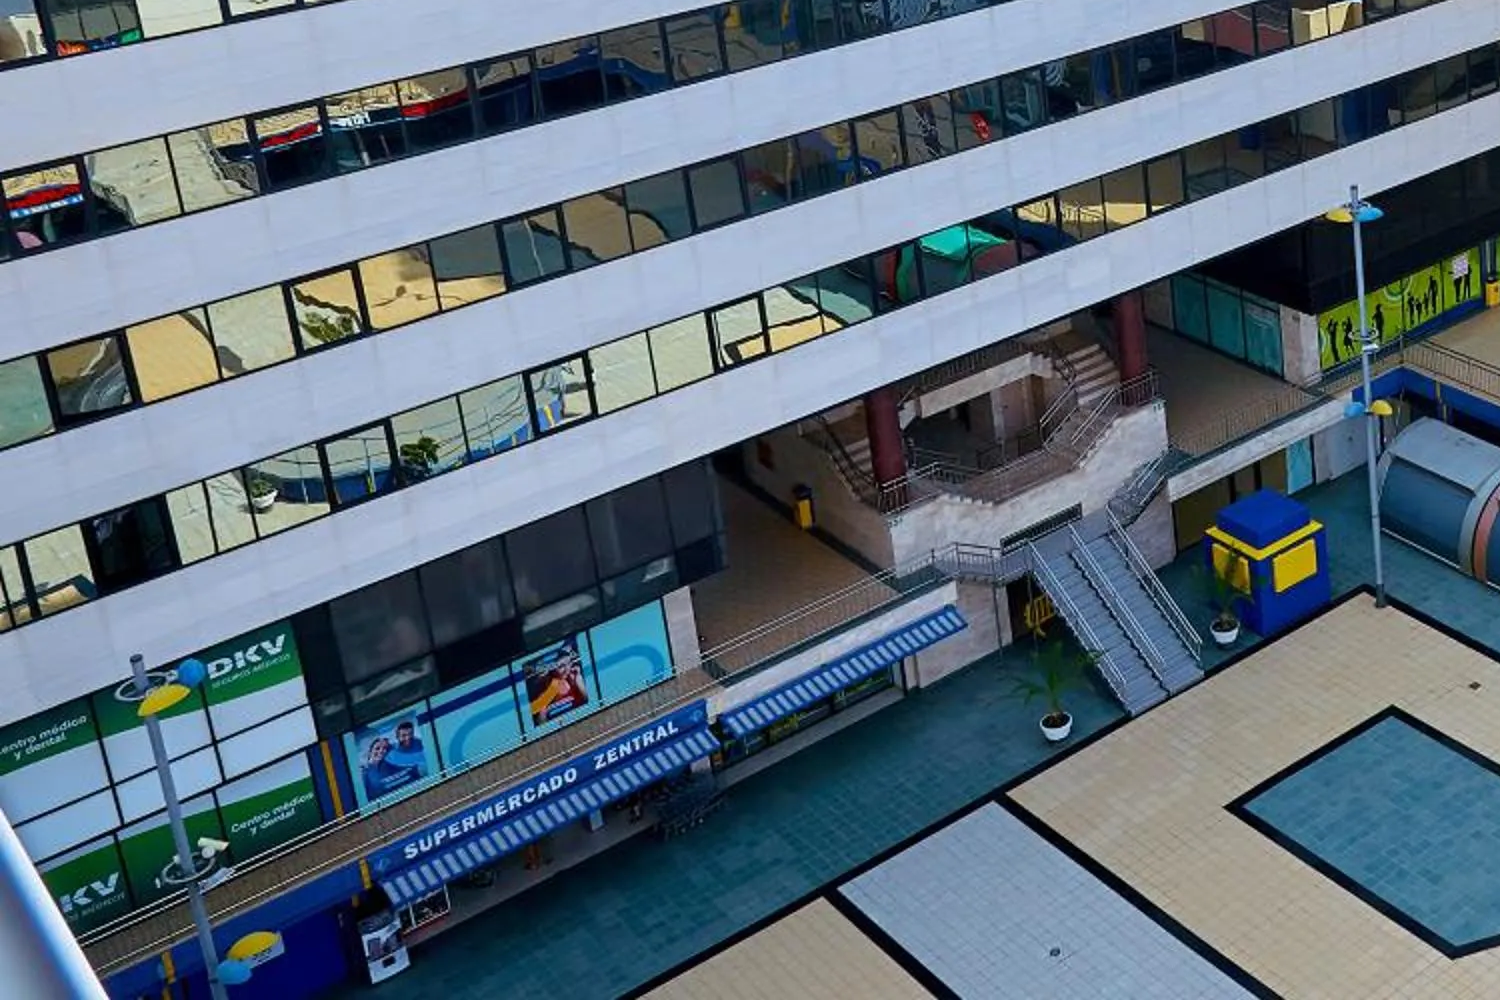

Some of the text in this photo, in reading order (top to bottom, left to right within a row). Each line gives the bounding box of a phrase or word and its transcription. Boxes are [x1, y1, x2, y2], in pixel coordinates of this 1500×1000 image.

[207, 633, 286, 680] DKV
[403, 720, 679, 860] SUPERMERCADO ZENTRAL
[60, 871, 120, 913] KV
